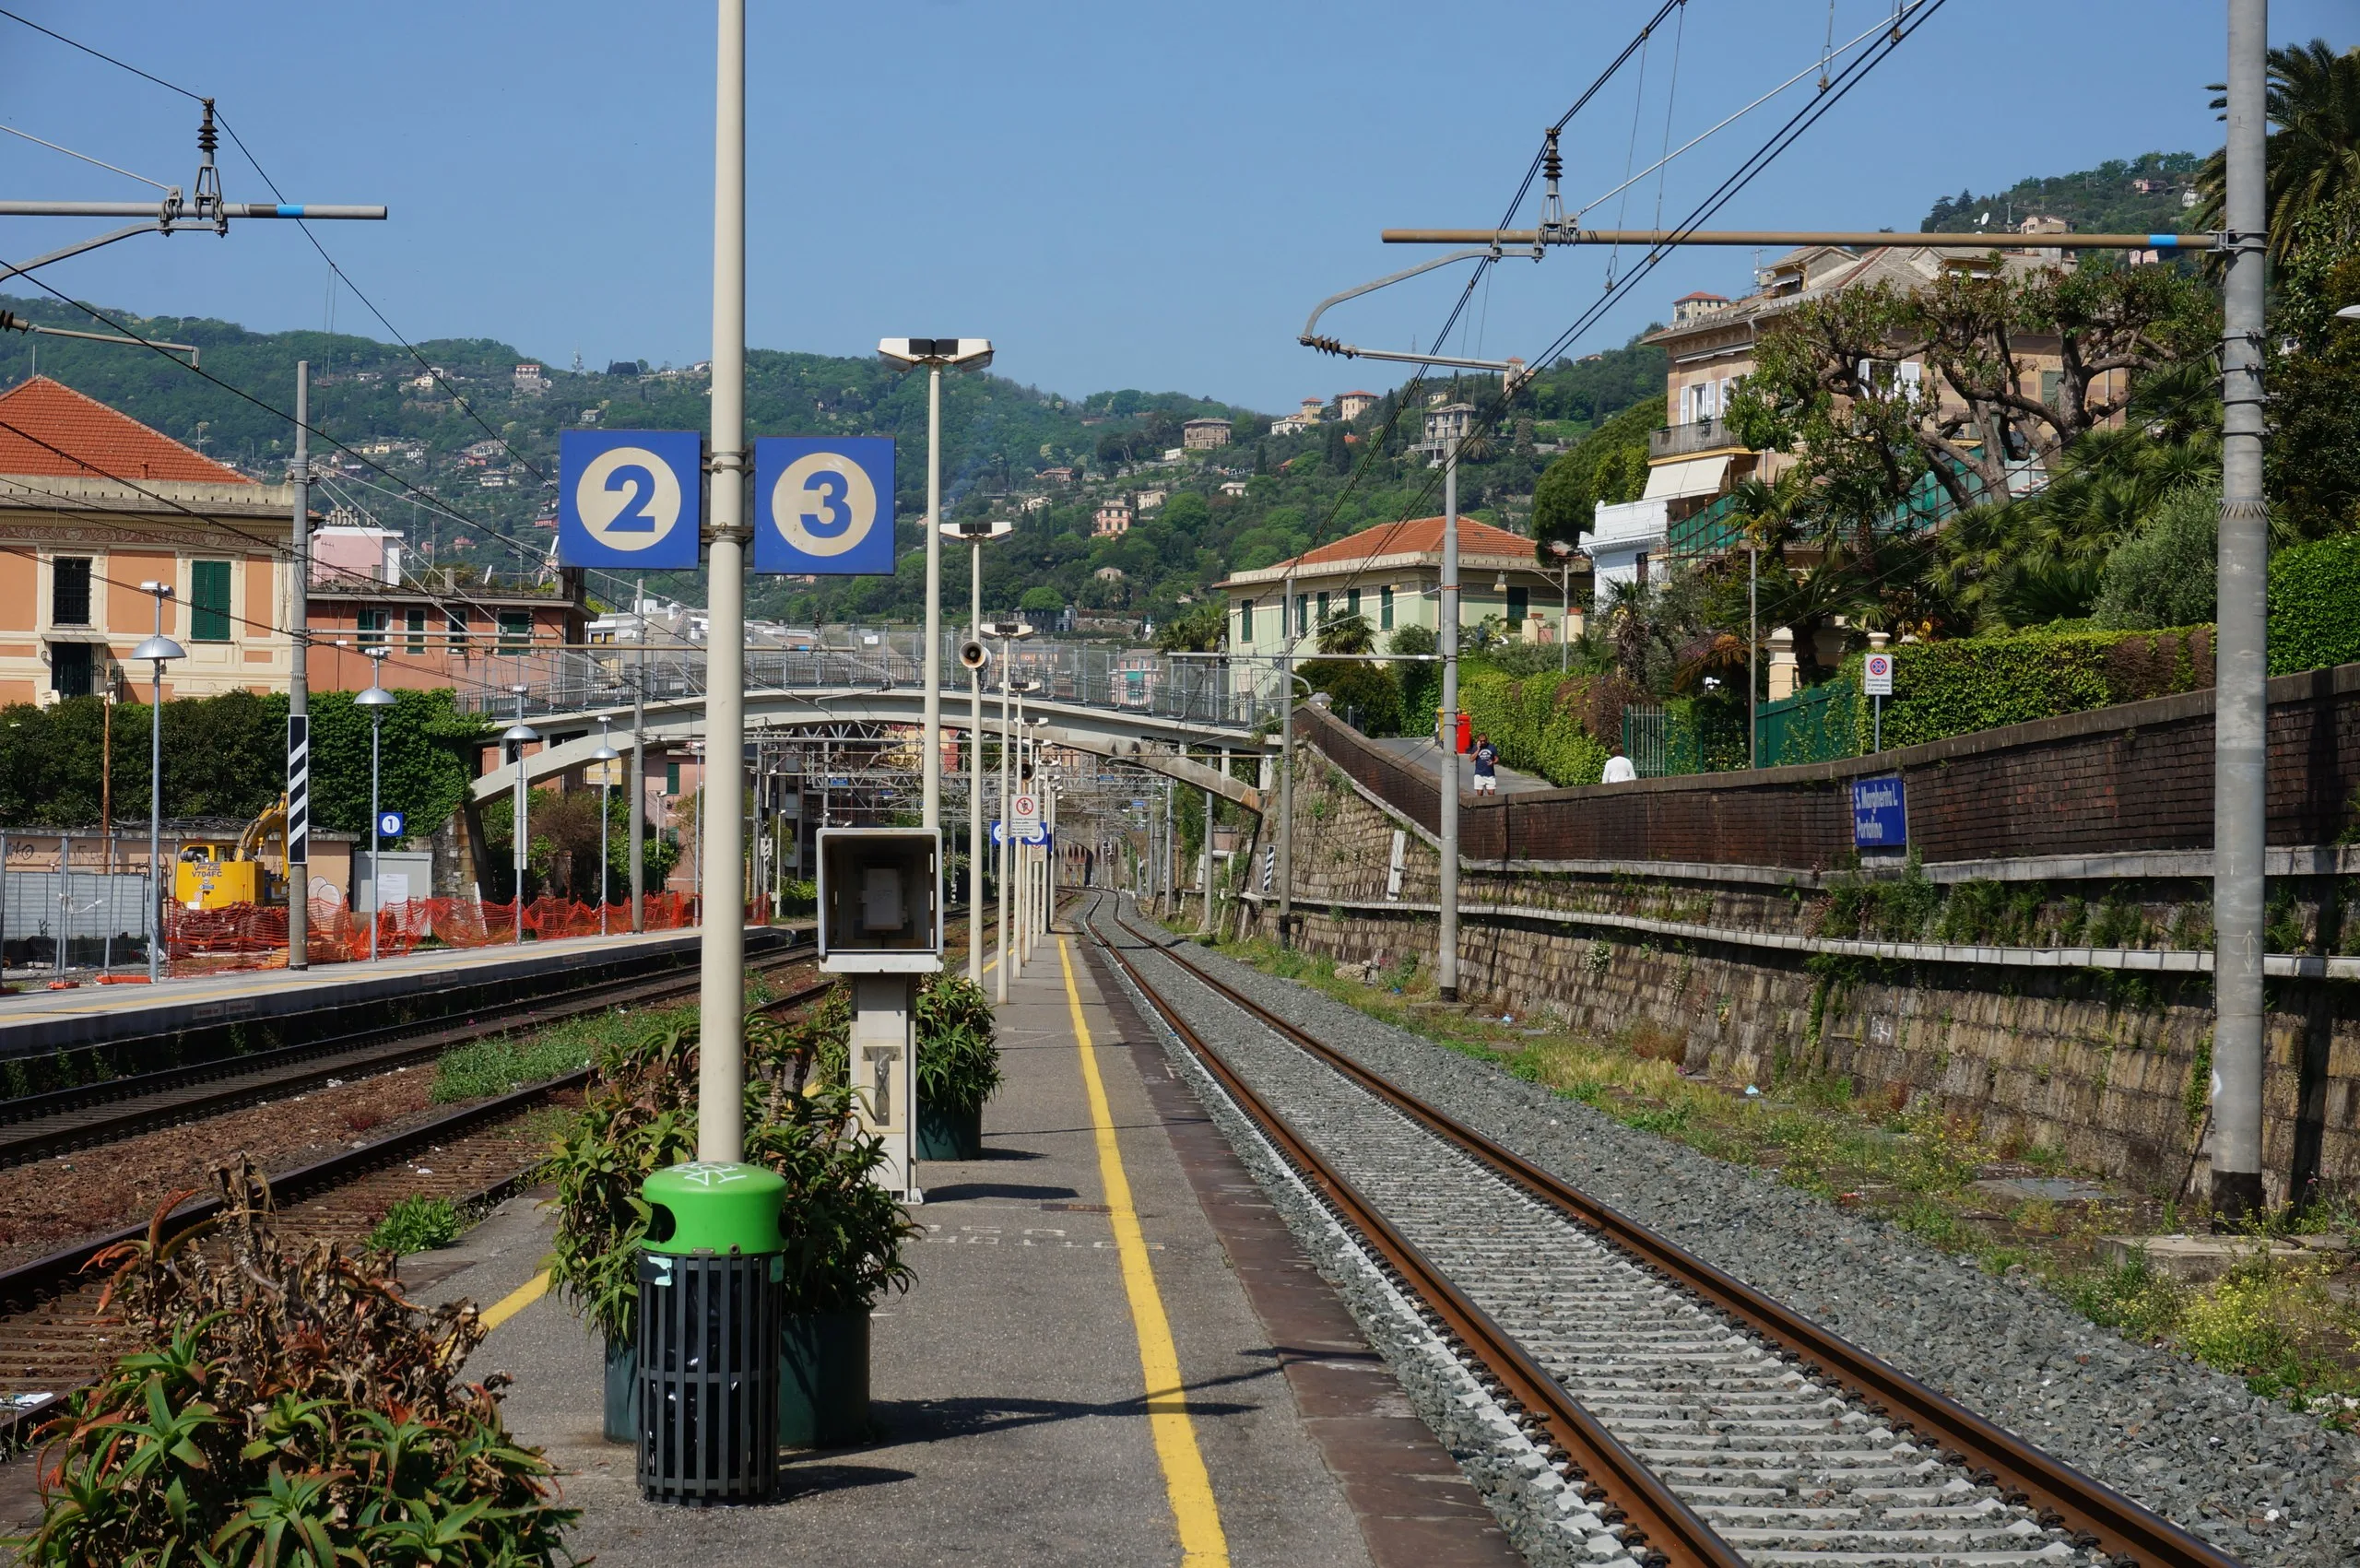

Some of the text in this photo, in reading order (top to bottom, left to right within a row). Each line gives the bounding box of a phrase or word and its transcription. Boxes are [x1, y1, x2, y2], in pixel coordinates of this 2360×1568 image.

[603, 463, 656, 533] 2
[799, 469, 854, 539] 3
[1860, 783, 1893, 815] Margherita
[387, 819, 393, 830] 1
[1856, 814, 1883, 840] Portofino
